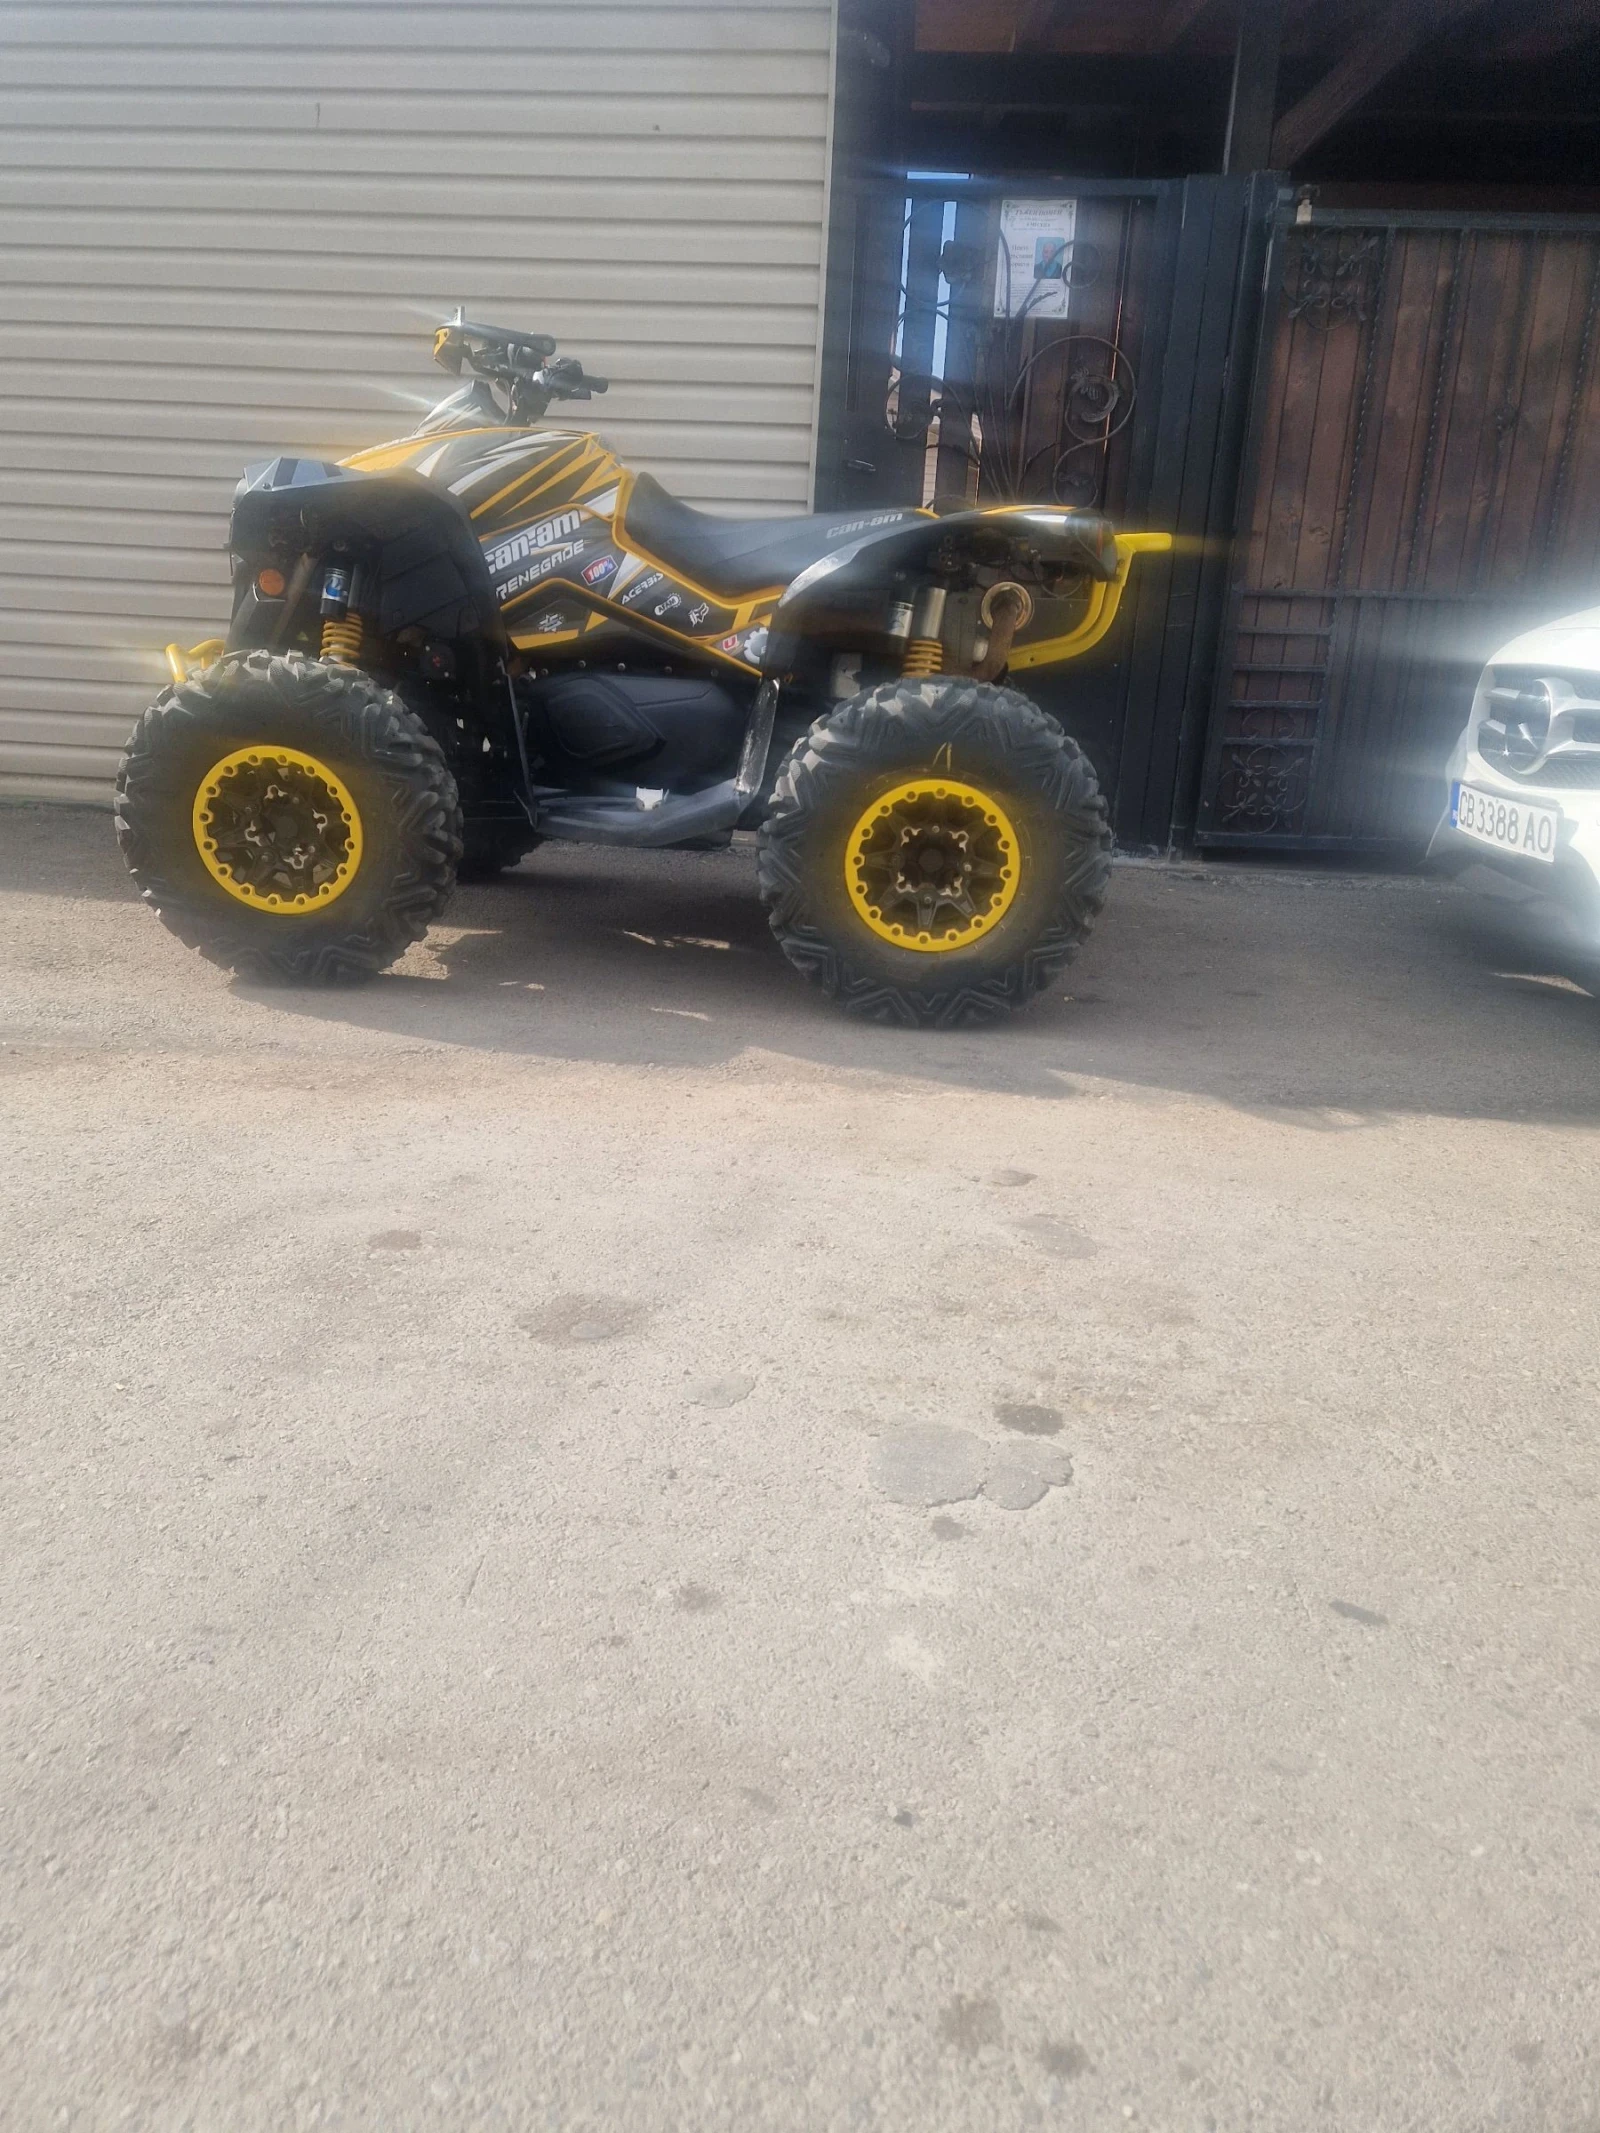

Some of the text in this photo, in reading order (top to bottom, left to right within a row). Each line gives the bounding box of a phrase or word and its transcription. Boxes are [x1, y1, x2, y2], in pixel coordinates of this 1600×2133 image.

[826, 513, 903, 539] can-am
[495, 539, 584, 600] RENEGADE
[588, 557, 614, 581] 100%
[1459, 791, 1552, 854] CB 3388 AO
